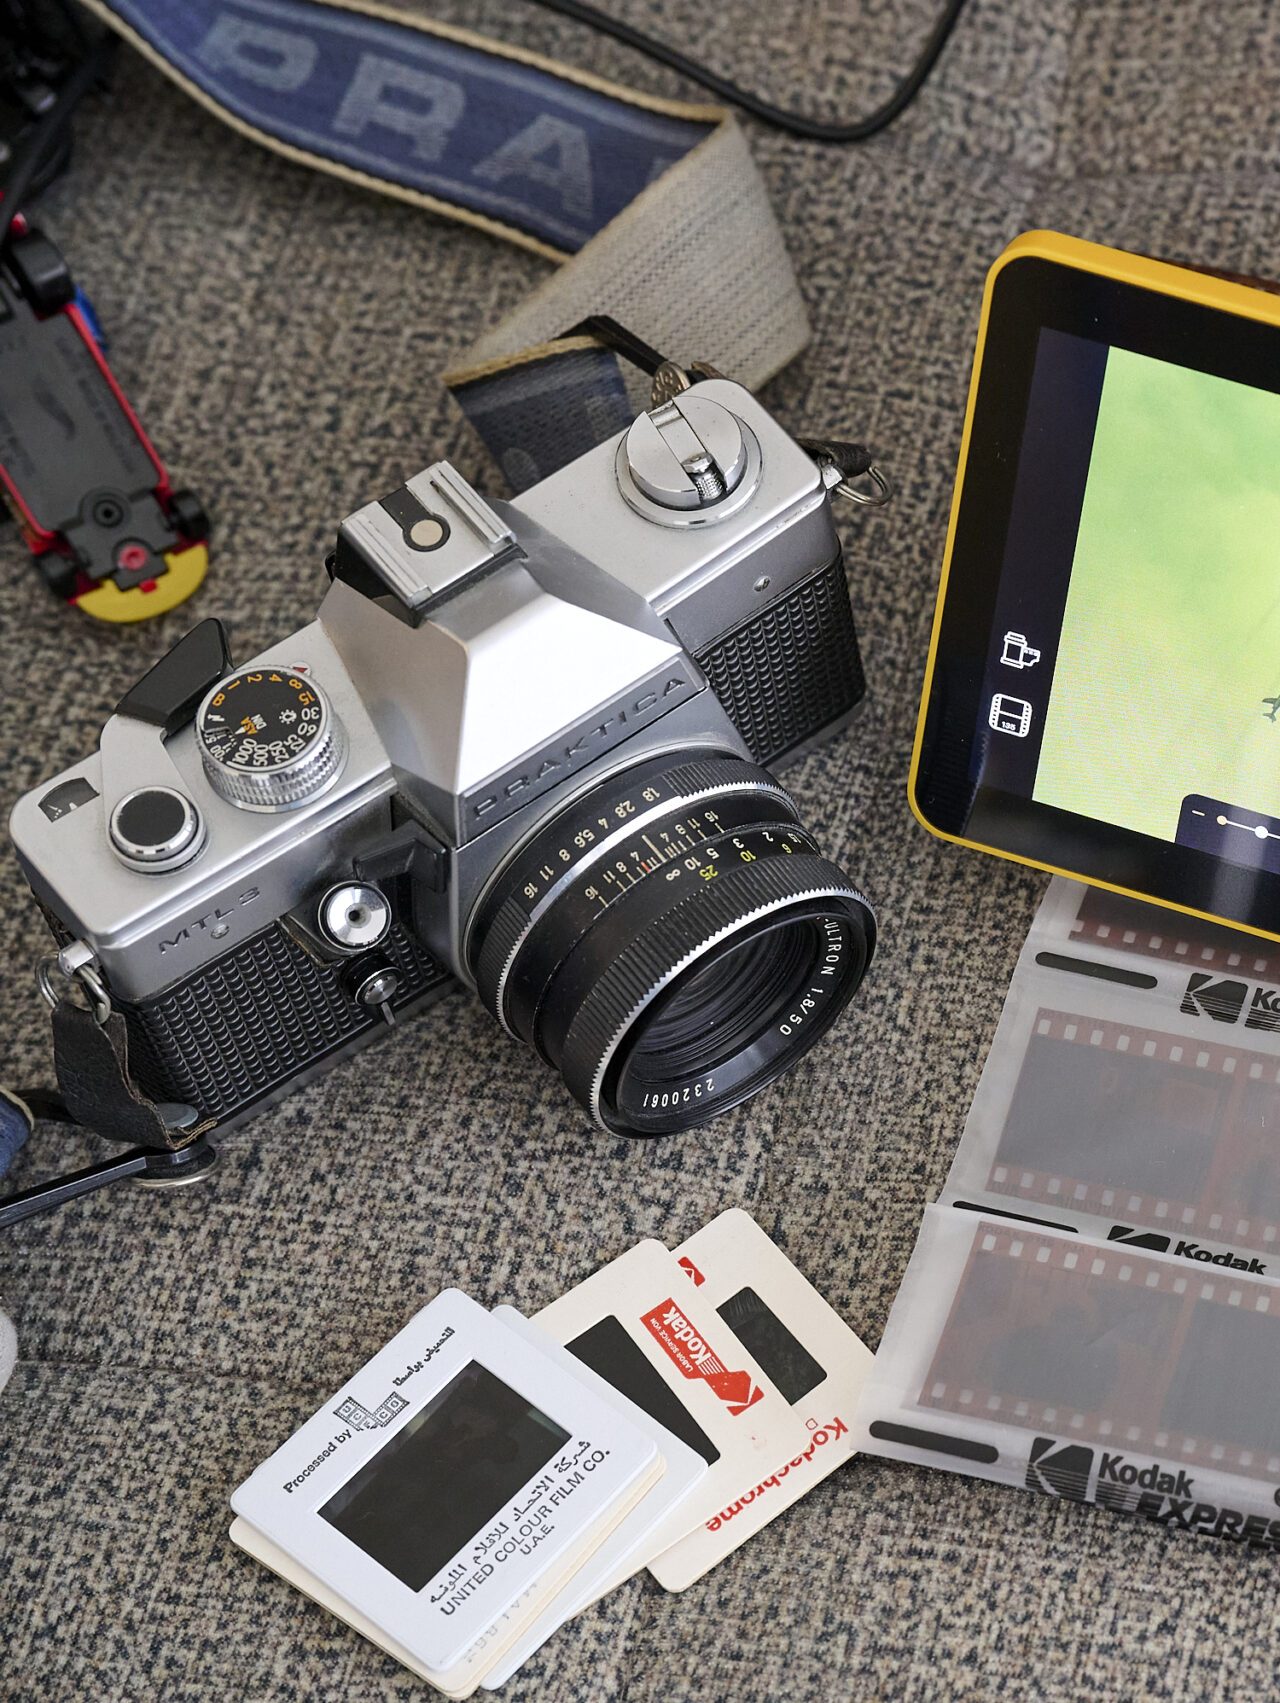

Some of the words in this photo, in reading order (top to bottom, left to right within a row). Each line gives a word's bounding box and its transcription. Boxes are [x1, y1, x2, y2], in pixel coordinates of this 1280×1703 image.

[198, 14, 672, 220] PRA
[212, 692, 226, 706] B
[227, 680, 241, 691] 1
[247, 673, 263, 684] 2
[269, 673, 283, 683] 4
[289, 679, 302, 690] 8
[241, 716, 259, 735] ASA
[251, 713, 268, 730] DIN
[473, 676, 687, 821] PRAKTICA
[597, 818, 609, 829] 4
[687, 818, 701, 829] 11
[704, 810, 719, 823] 16
[675, 824, 686, 835] 8
[558, 849, 571, 861] 8
[706, 848, 720, 860] 5
[740, 850, 757, 863] 10
[615, 861, 627, 873] 8
[684, 856, 701, 870] 10
[539, 866, 554, 881] 11
[603, 870, 617, 884] 11
[699, 864, 718, 881] 25
[524, 882, 538, 899] 16
[585, 886, 598, 900] 16
[643, 1078, 714, 1108] 2320061
[1173, 1240, 1267, 1276] Kodak
[650, 1318, 662, 1331] VON
[659, 1330, 680, 1354] SERVICE
[661, 1305, 712, 1366] Kodak
[677, 1352, 694, 1372] LABOR
[282, 1443, 335, 1494] Processed
[335, 1428, 353, 1452] by
[1100, 1452, 1195, 1499] Kodak
[440, 1563, 495, 1616] UNITED
[494, 1506, 553, 1565] COLOUR
[549, 1471, 586, 1507] FILM
[583, 1449, 611, 1473] CO.
[519, 1523, 556, 1556] U.A.E.
